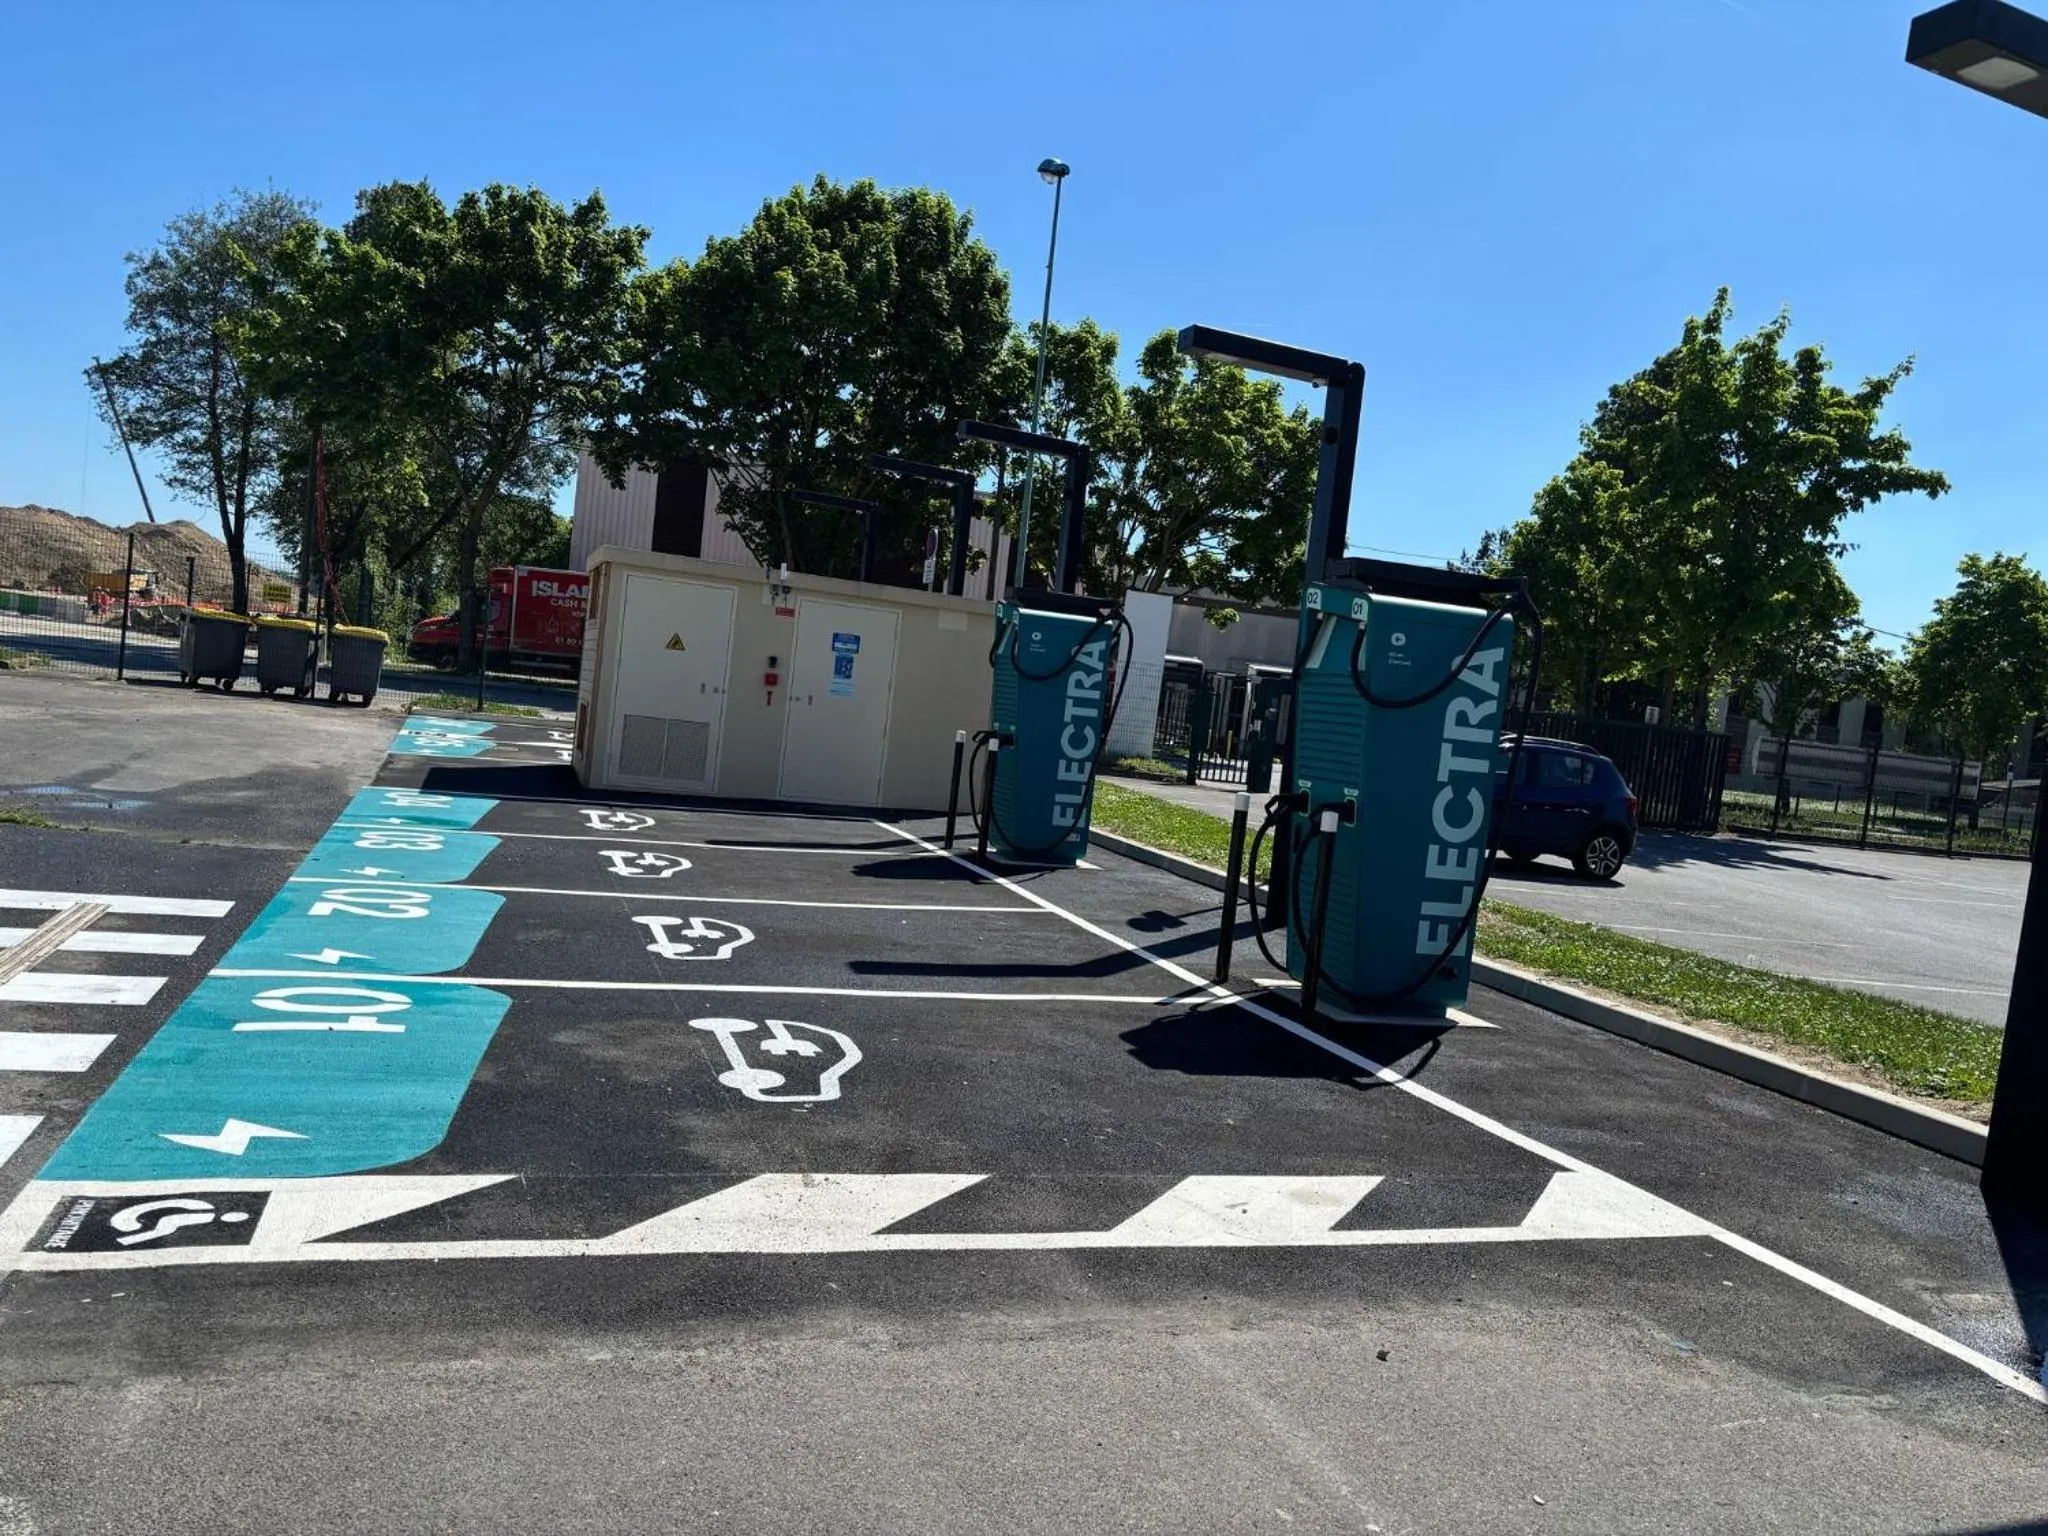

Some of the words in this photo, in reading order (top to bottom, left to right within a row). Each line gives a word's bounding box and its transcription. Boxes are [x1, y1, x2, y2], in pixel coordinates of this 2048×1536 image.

[550, 598, 578, 607] CASH
[1307, 591, 1319, 605] 02
[1052, 638, 1108, 843] ELECTRA
[1416, 645, 1505, 958] ELECTRA
[355, 831, 444, 851] 03
[308, 887, 432, 919] 02
[232, 985, 414, 1033] 01
